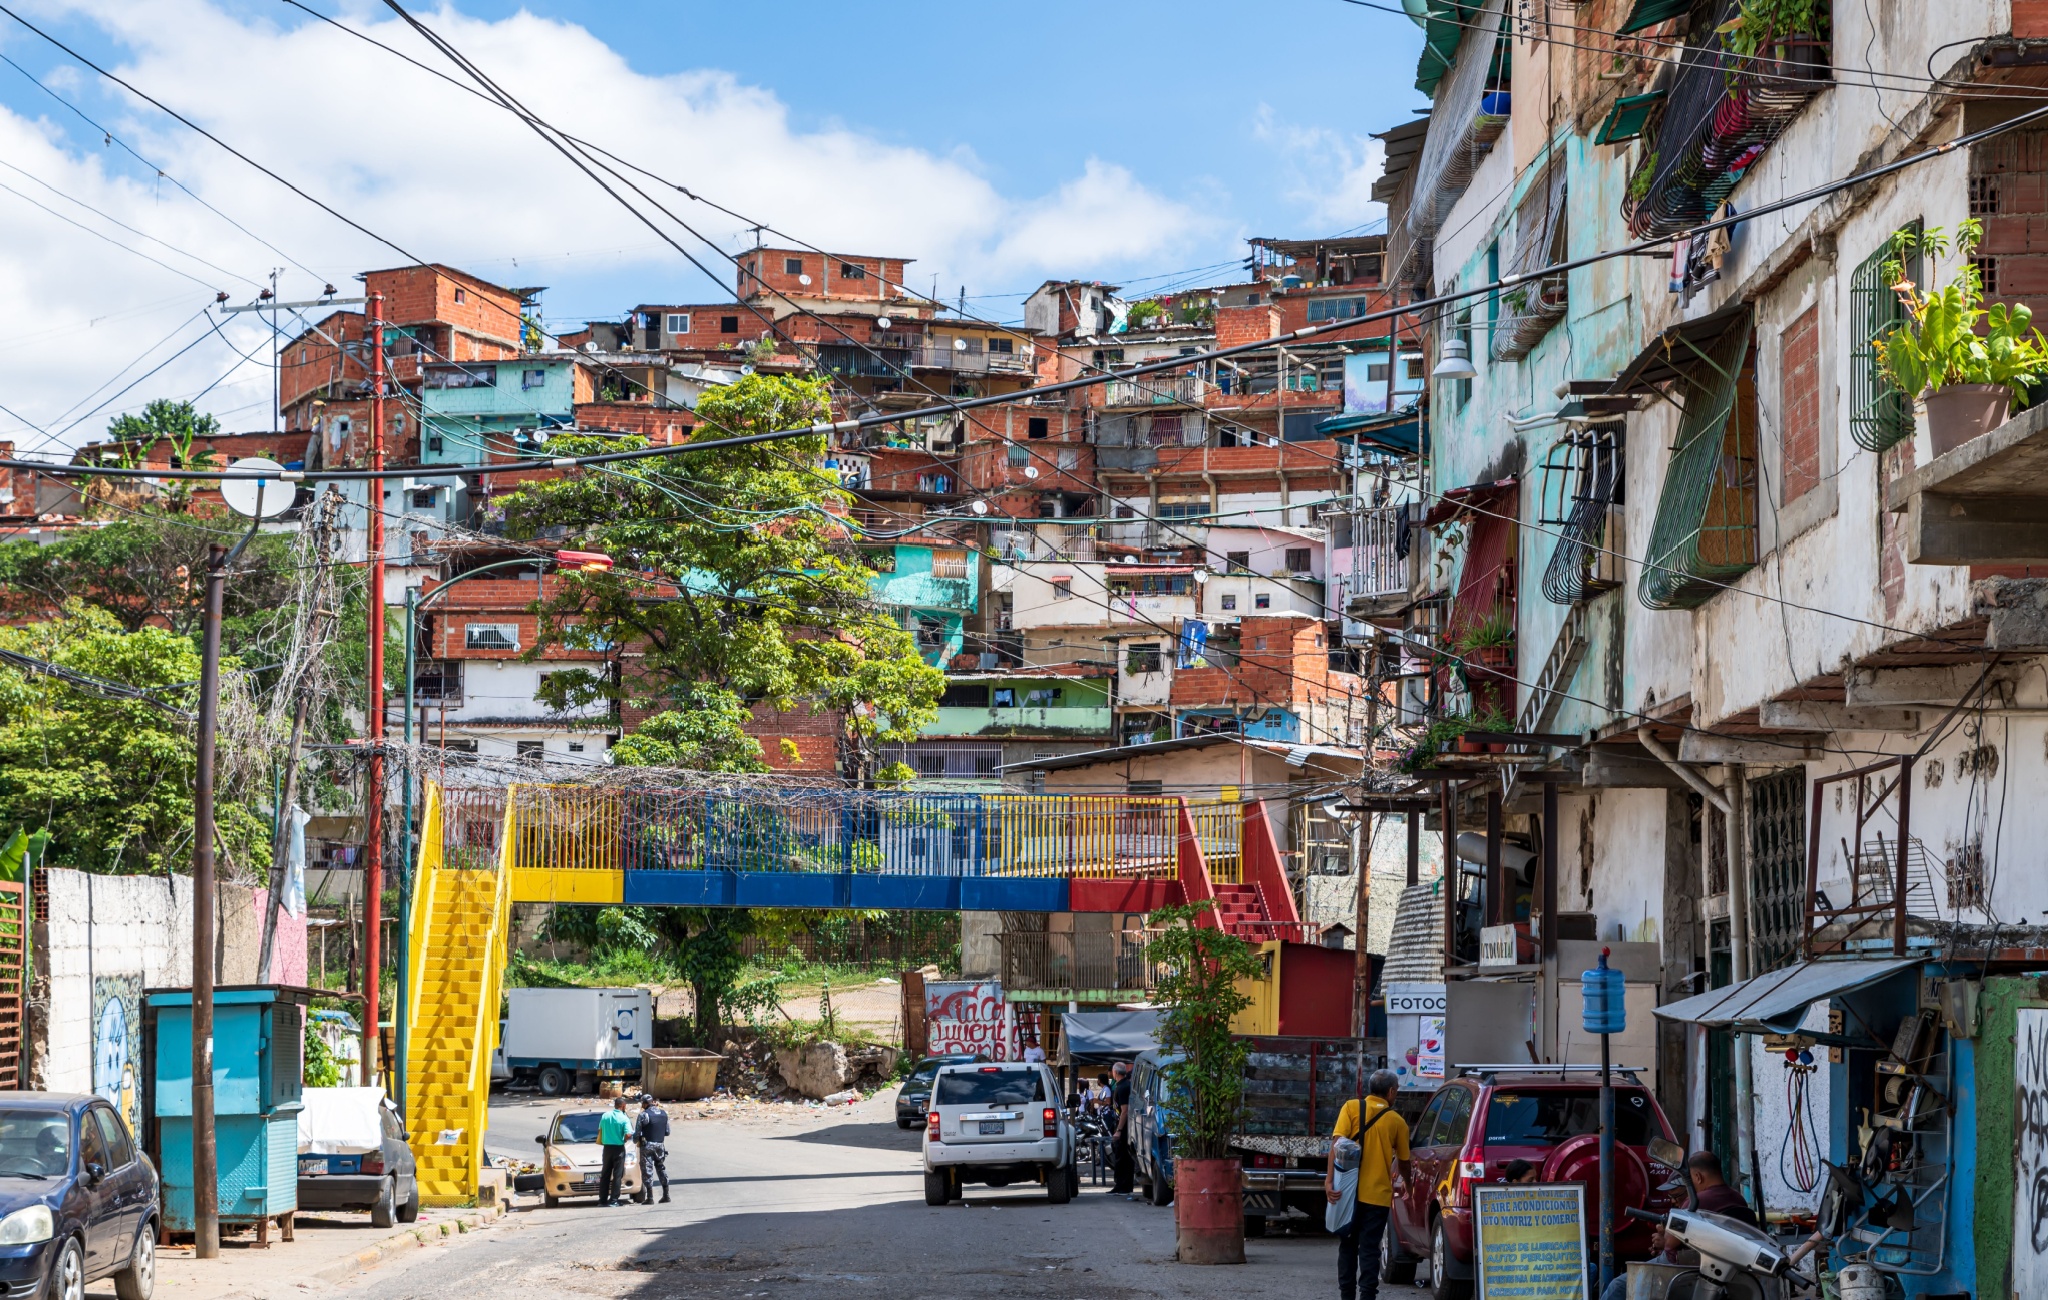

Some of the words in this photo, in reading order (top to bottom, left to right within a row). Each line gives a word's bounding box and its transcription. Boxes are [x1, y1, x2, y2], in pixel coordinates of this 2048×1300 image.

[1490, 1202, 1511, 1213] AIRE
[1501, 1215, 1532, 1227] MOTRIZ
[1534, 1215, 1540, 1227] Y
[1541, 1213, 1580, 1226] COMERCI
[1486, 1254, 1517, 1263] AUTO
